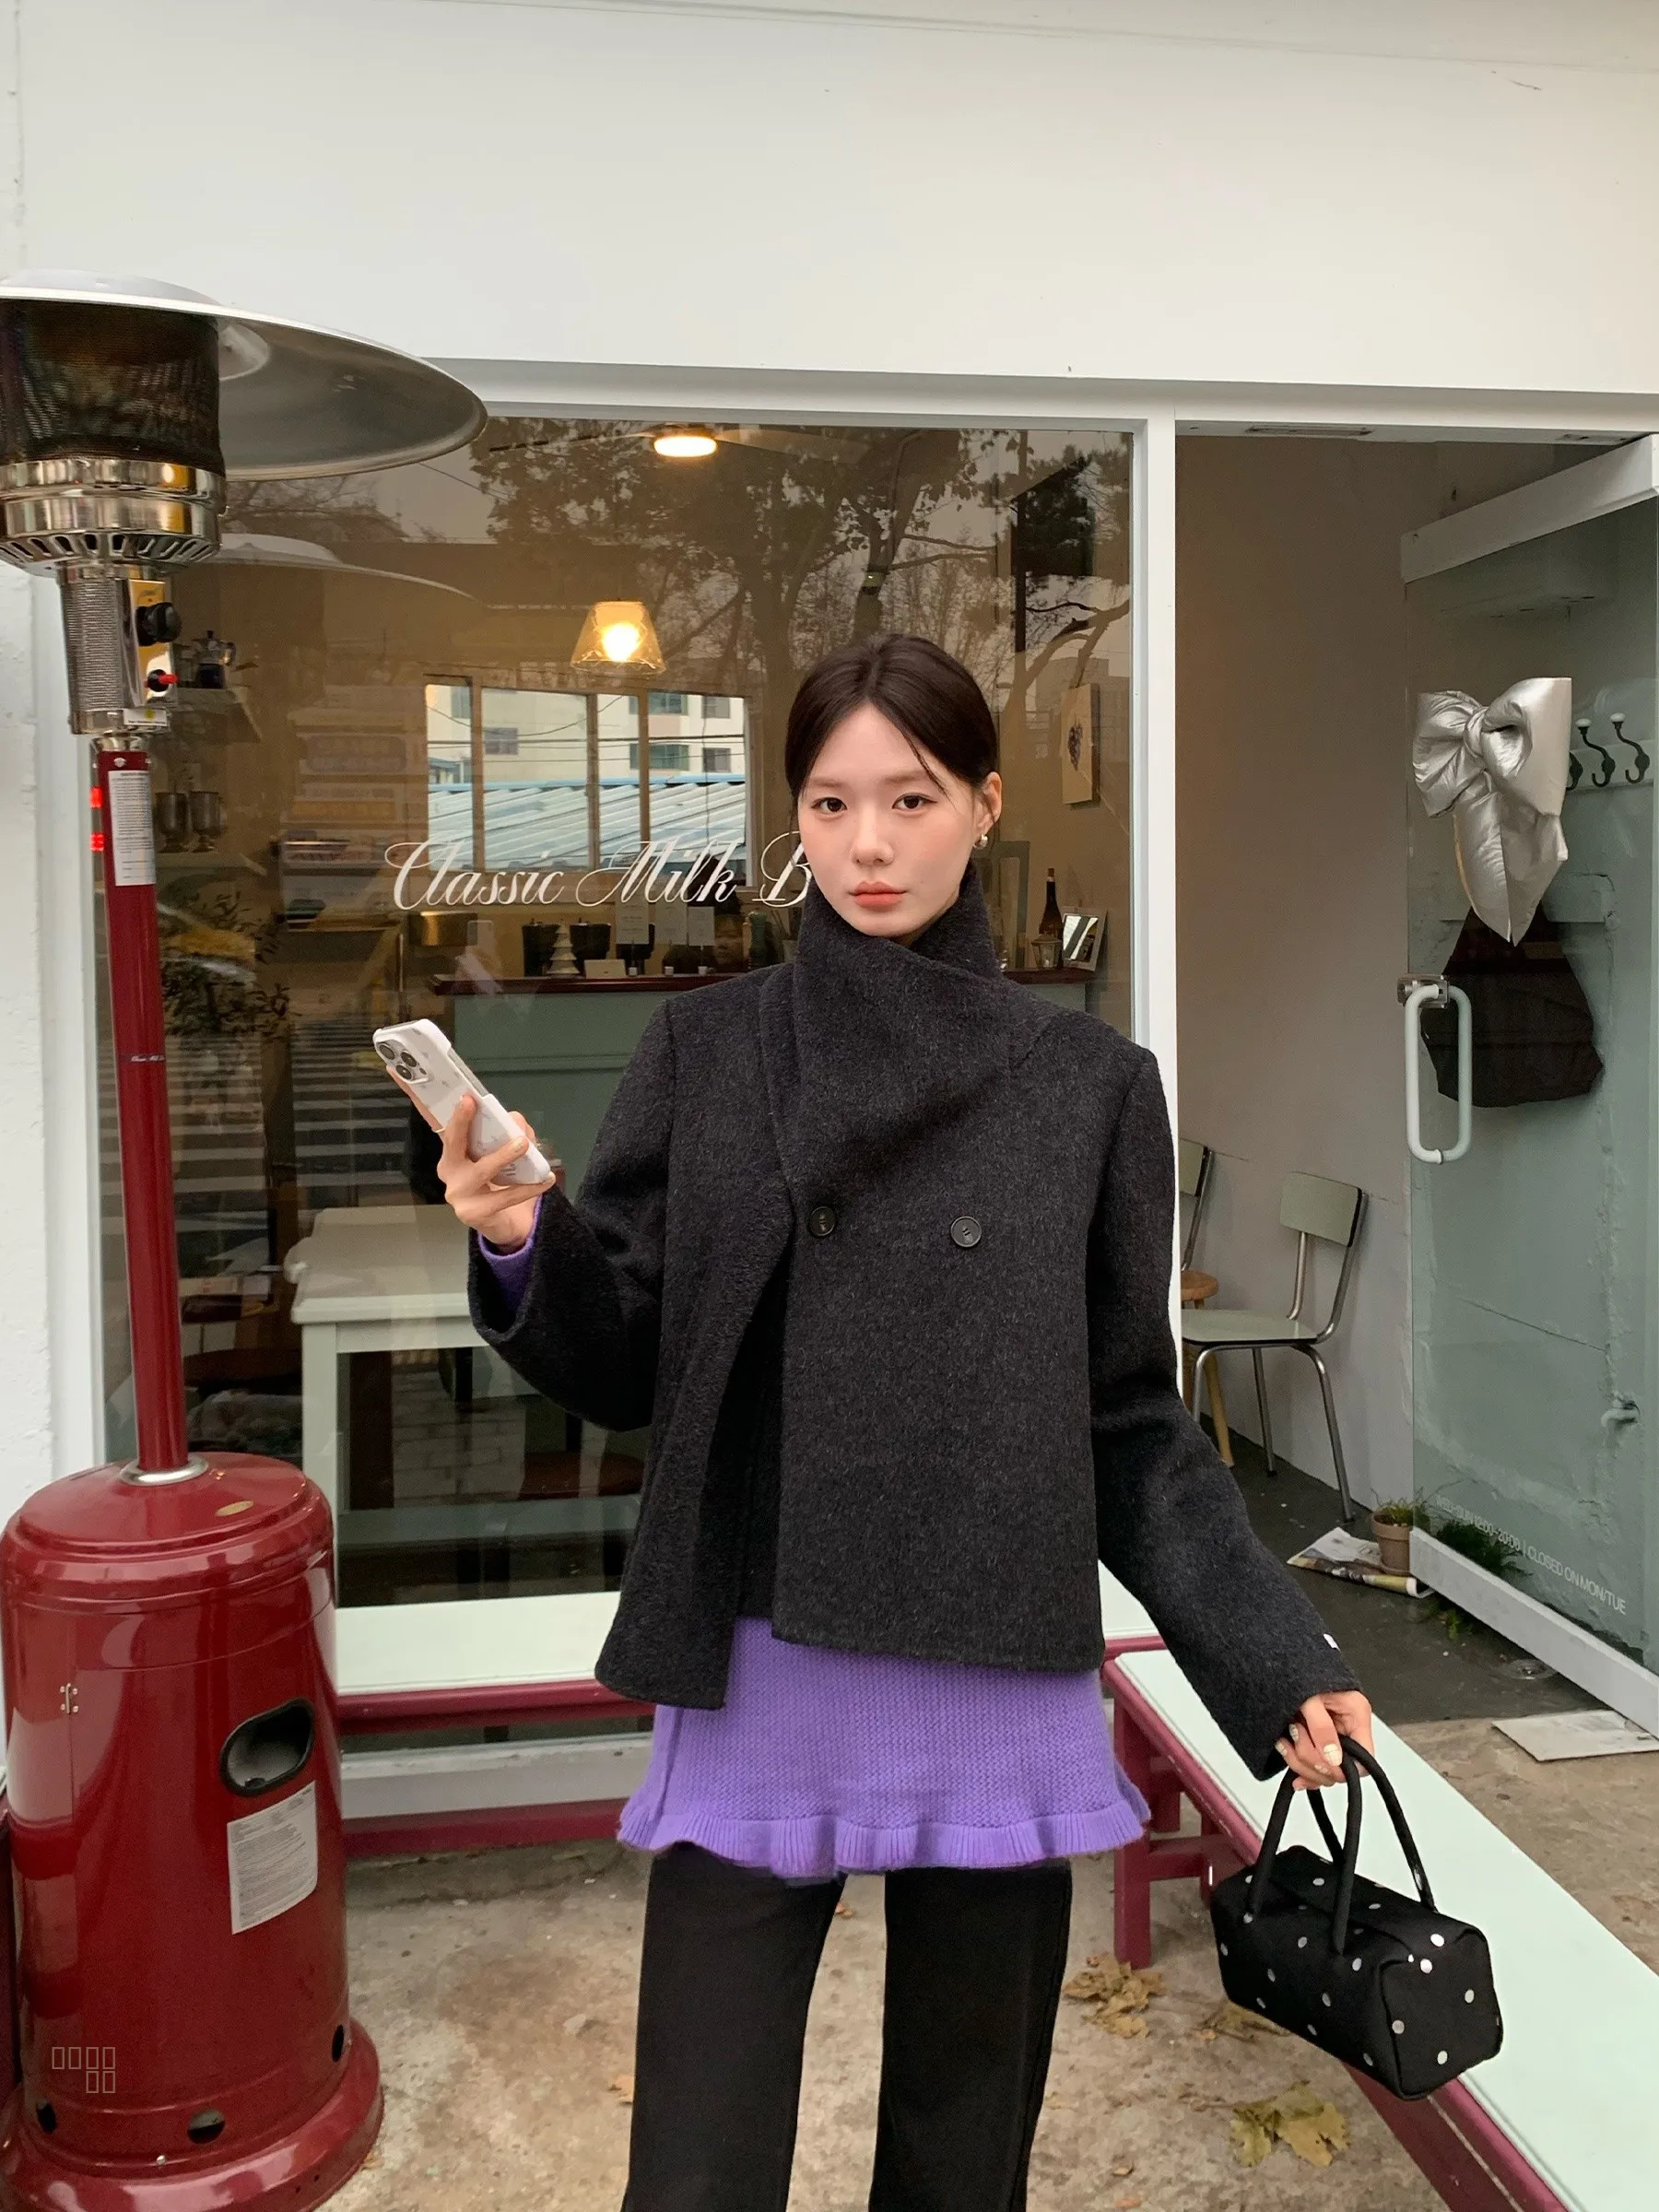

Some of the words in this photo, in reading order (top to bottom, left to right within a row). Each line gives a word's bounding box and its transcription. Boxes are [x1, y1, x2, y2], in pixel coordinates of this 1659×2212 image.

[384, 840, 565, 911] Classic
[575, 836, 739, 908] Milk
[1527, 1545, 1564, 1576] CLOSED
[1564, 1566, 1580, 1586] ON
